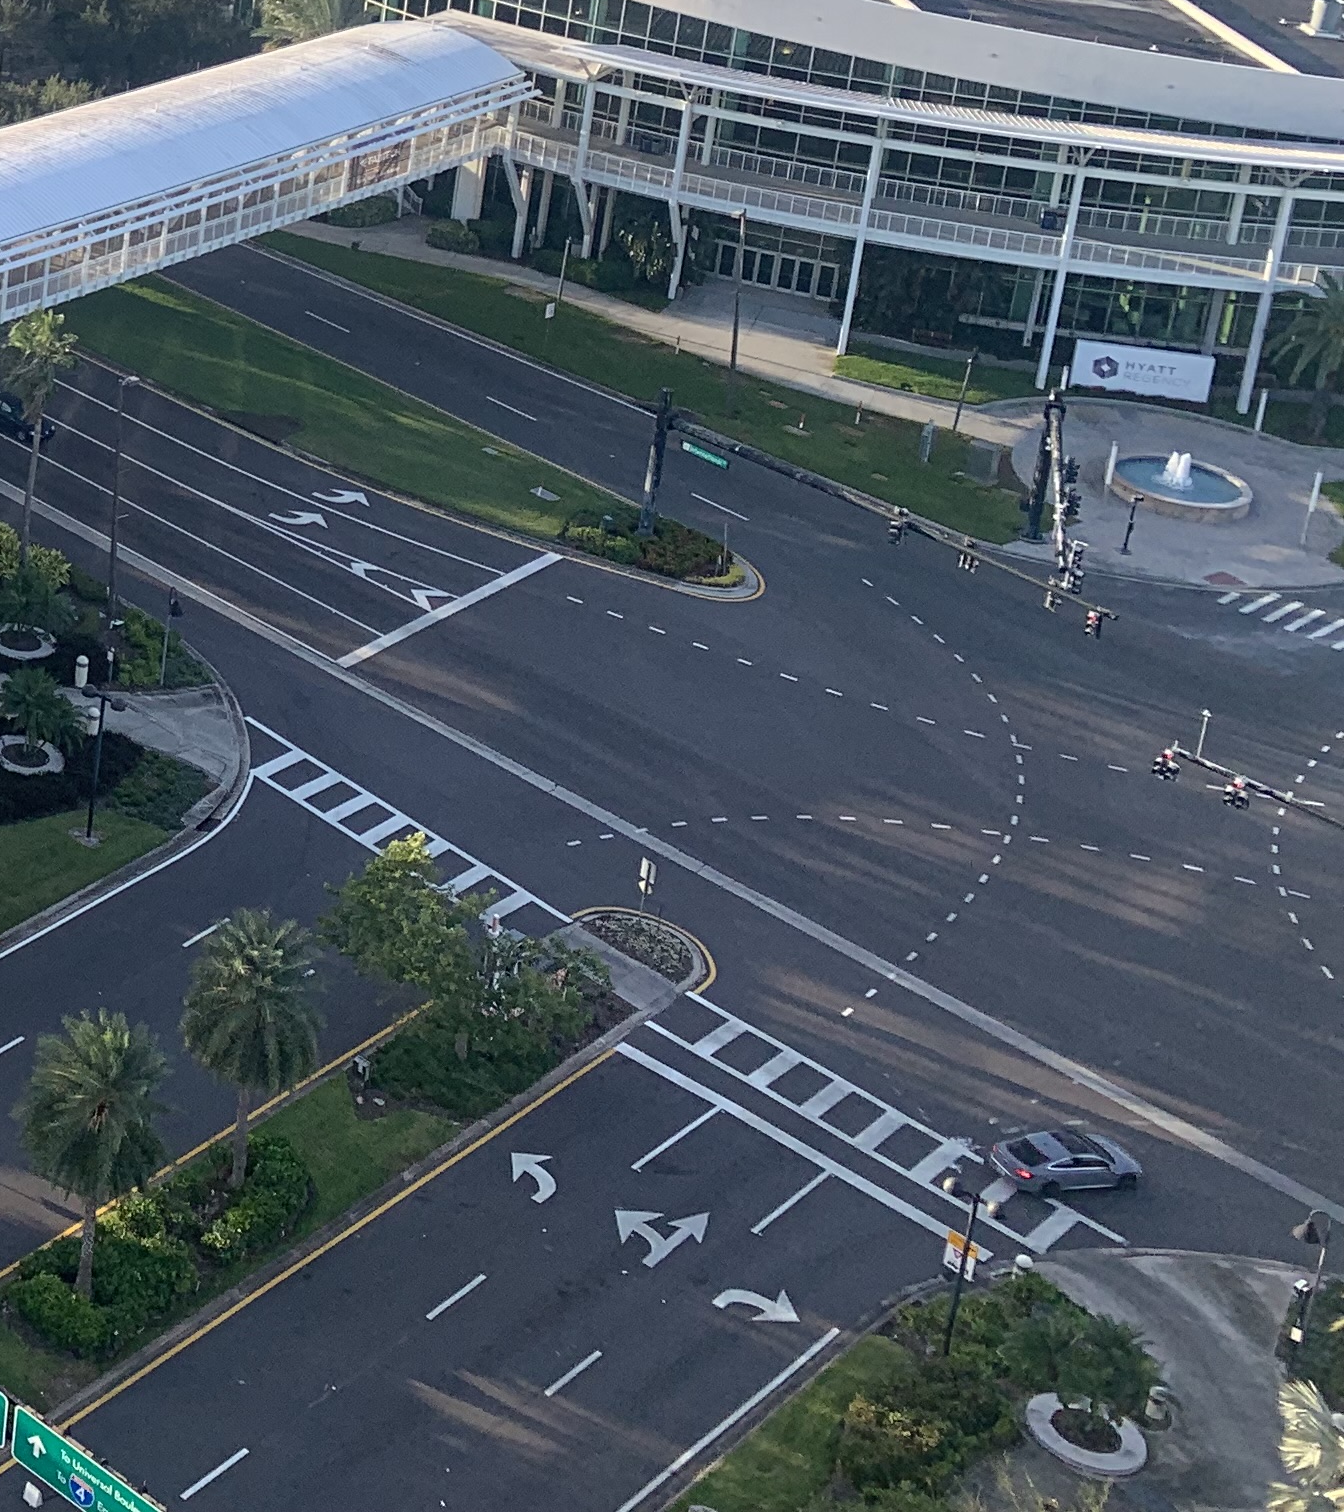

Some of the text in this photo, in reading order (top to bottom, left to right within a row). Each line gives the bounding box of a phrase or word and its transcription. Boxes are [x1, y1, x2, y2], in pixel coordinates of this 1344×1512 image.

[1123, 372, 1192, 388] REGENCY
[1125, 361, 1177, 375] HYATT
[61, 1449, 71, 1464] To
[72, 1459, 113, 1496] Universal
[56, 1469, 67, 1485] To
[75, 1487, 85, 1502] 4
